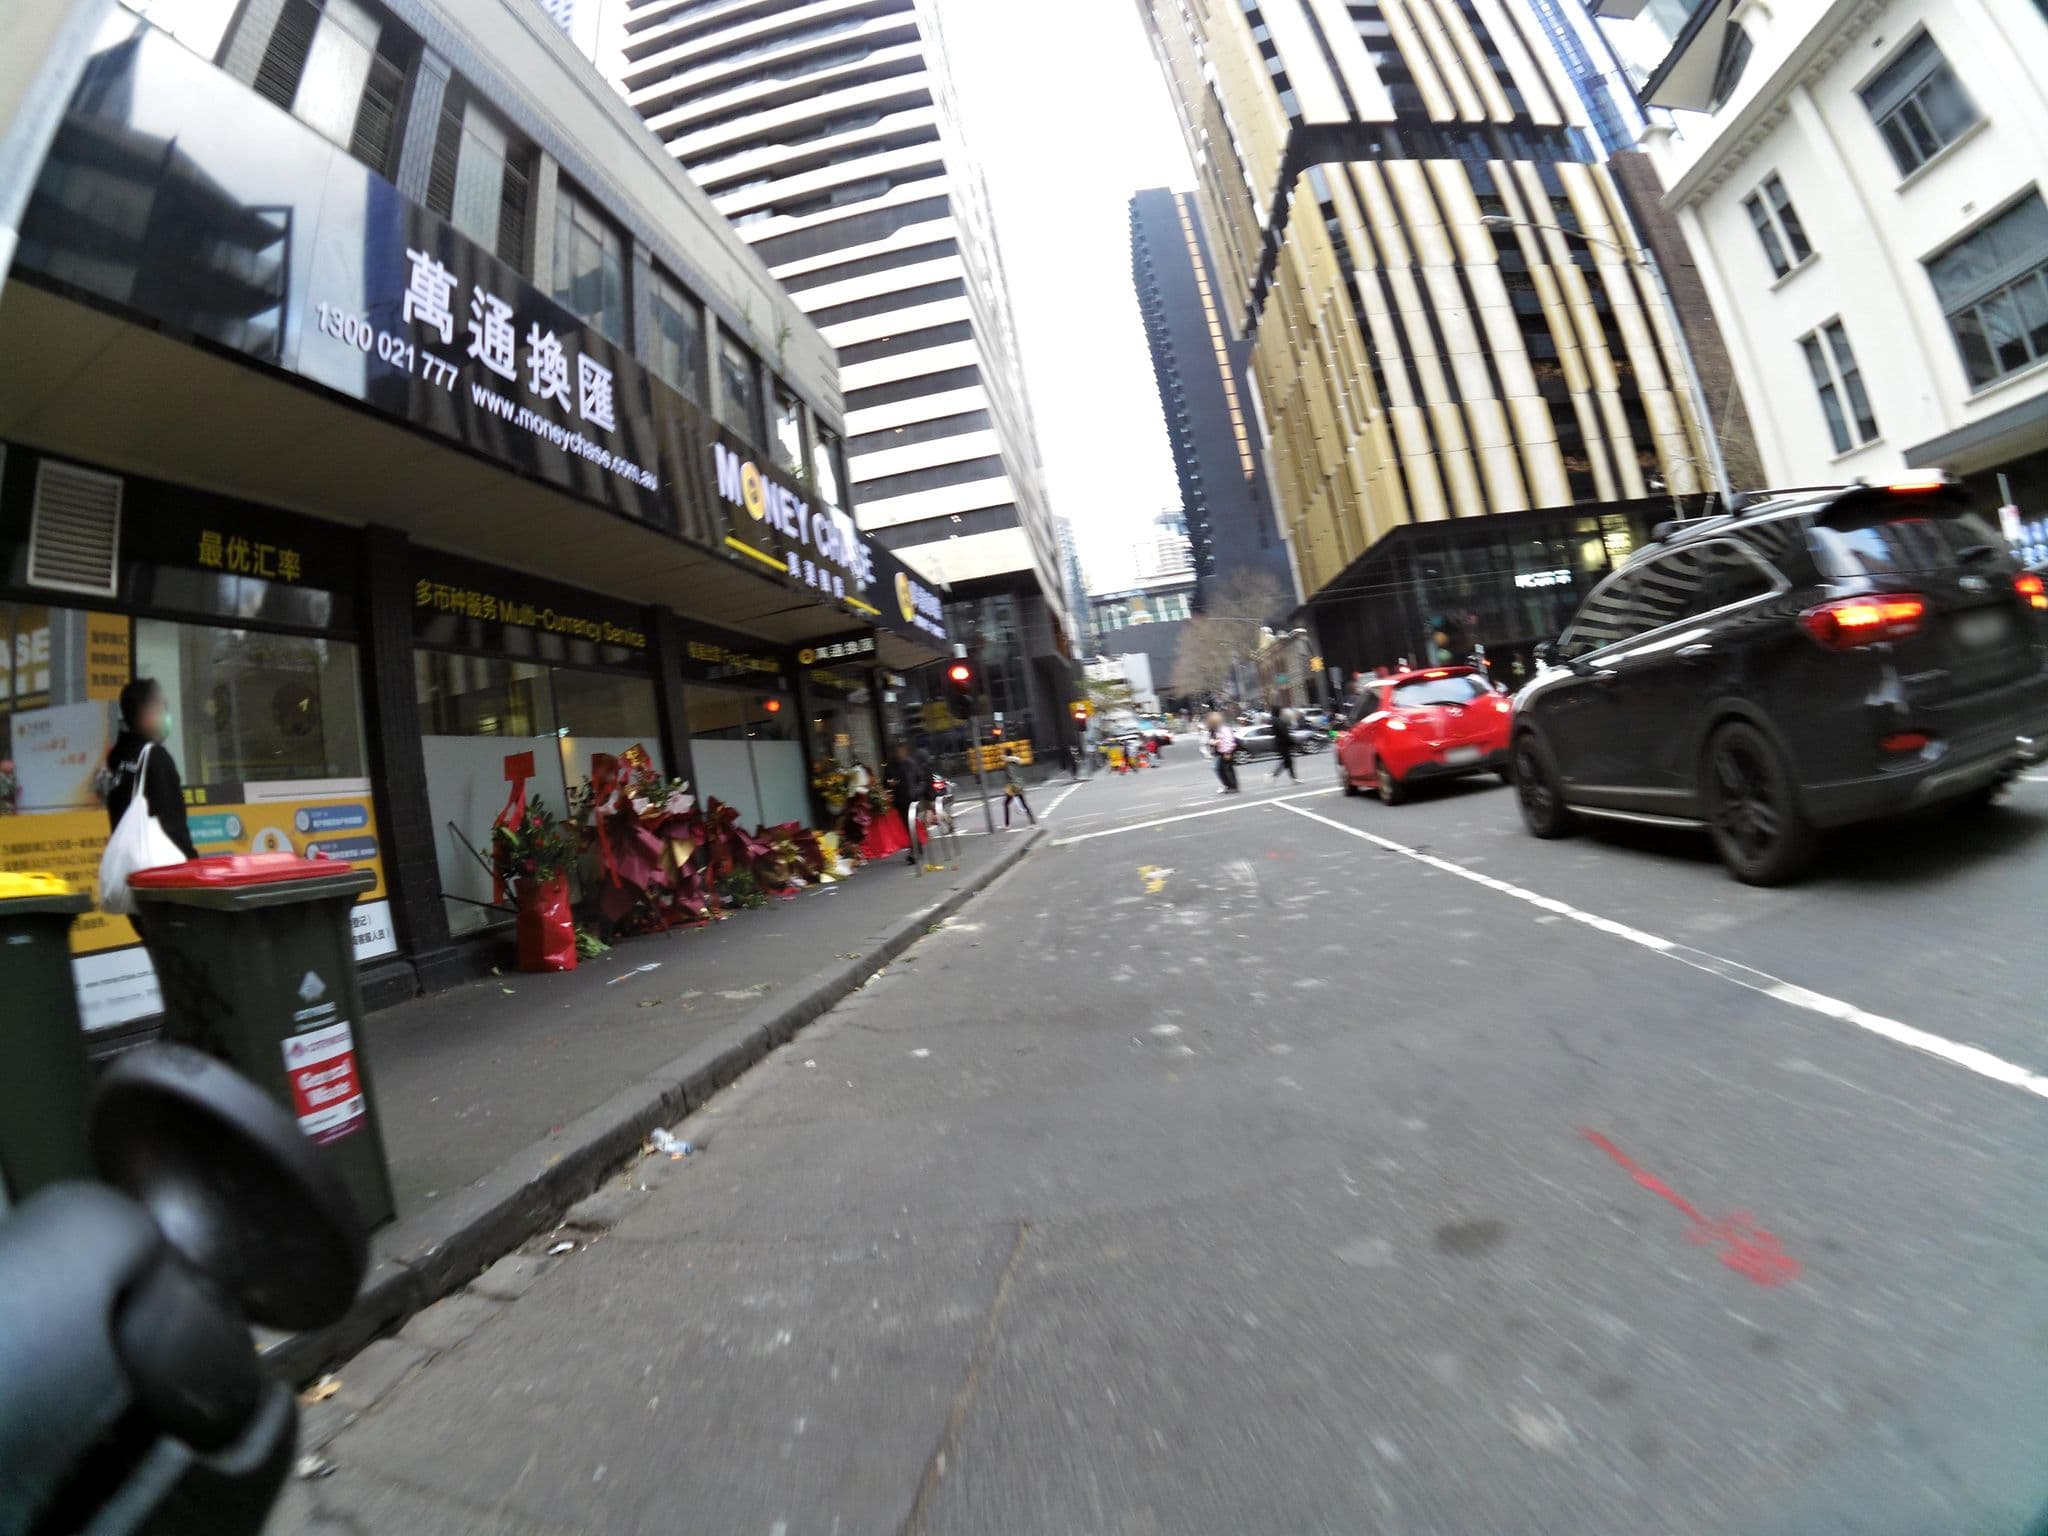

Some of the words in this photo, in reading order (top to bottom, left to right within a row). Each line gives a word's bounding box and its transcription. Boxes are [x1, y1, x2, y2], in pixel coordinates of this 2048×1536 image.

[315, 301, 373, 352] 1300
[377, 330, 415, 373] 021
[421, 350, 459, 392] 777
[403, 247, 616, 433] 萬通換匯
[714, 442, 810, 545] MONEY
[198, 530, 302, 581] 最优汇率
